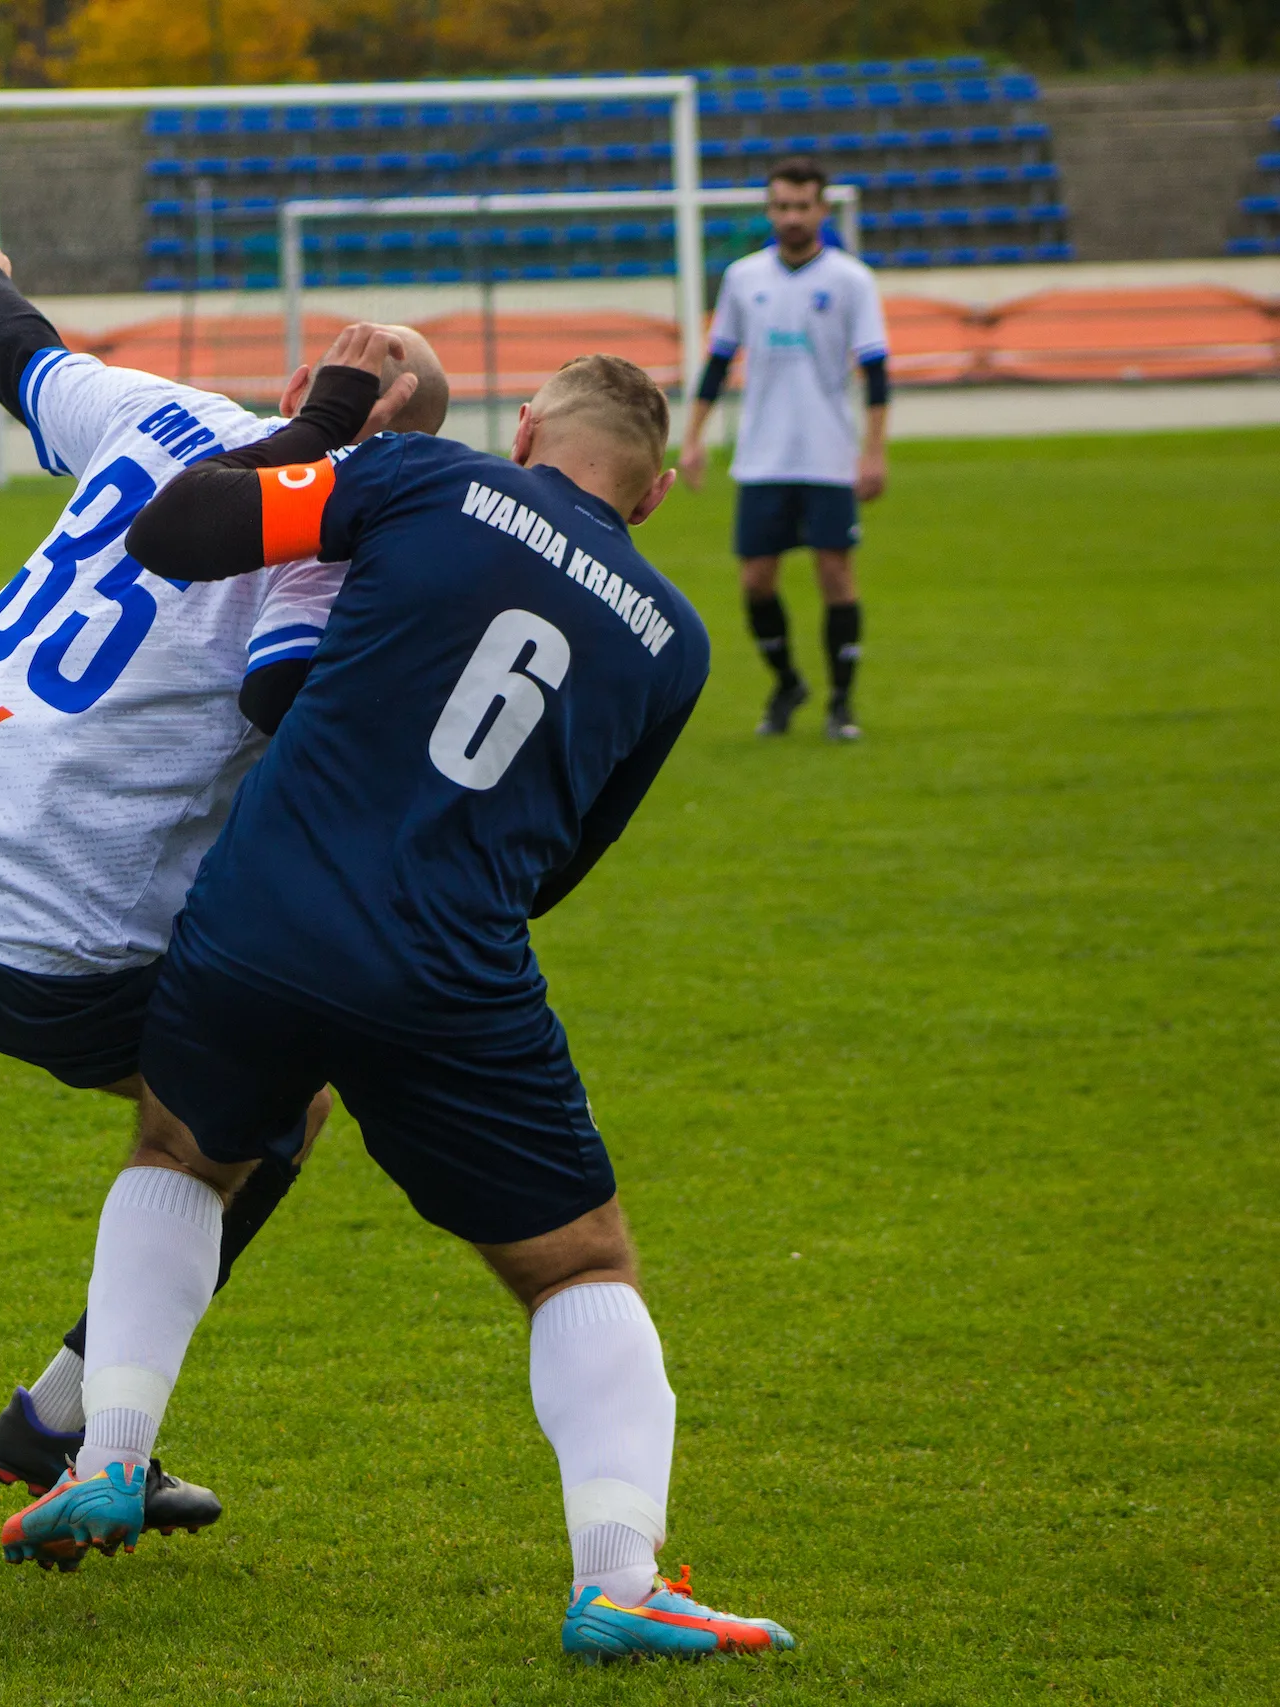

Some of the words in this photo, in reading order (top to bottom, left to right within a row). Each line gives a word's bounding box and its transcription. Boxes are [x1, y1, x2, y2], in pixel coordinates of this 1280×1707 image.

[278, 467, 316, 489] C
[461, 481, 568, 568] WANDA
[566, 547, 675, 657] KRAKÓW
[428, 608, 571, 791] 6
